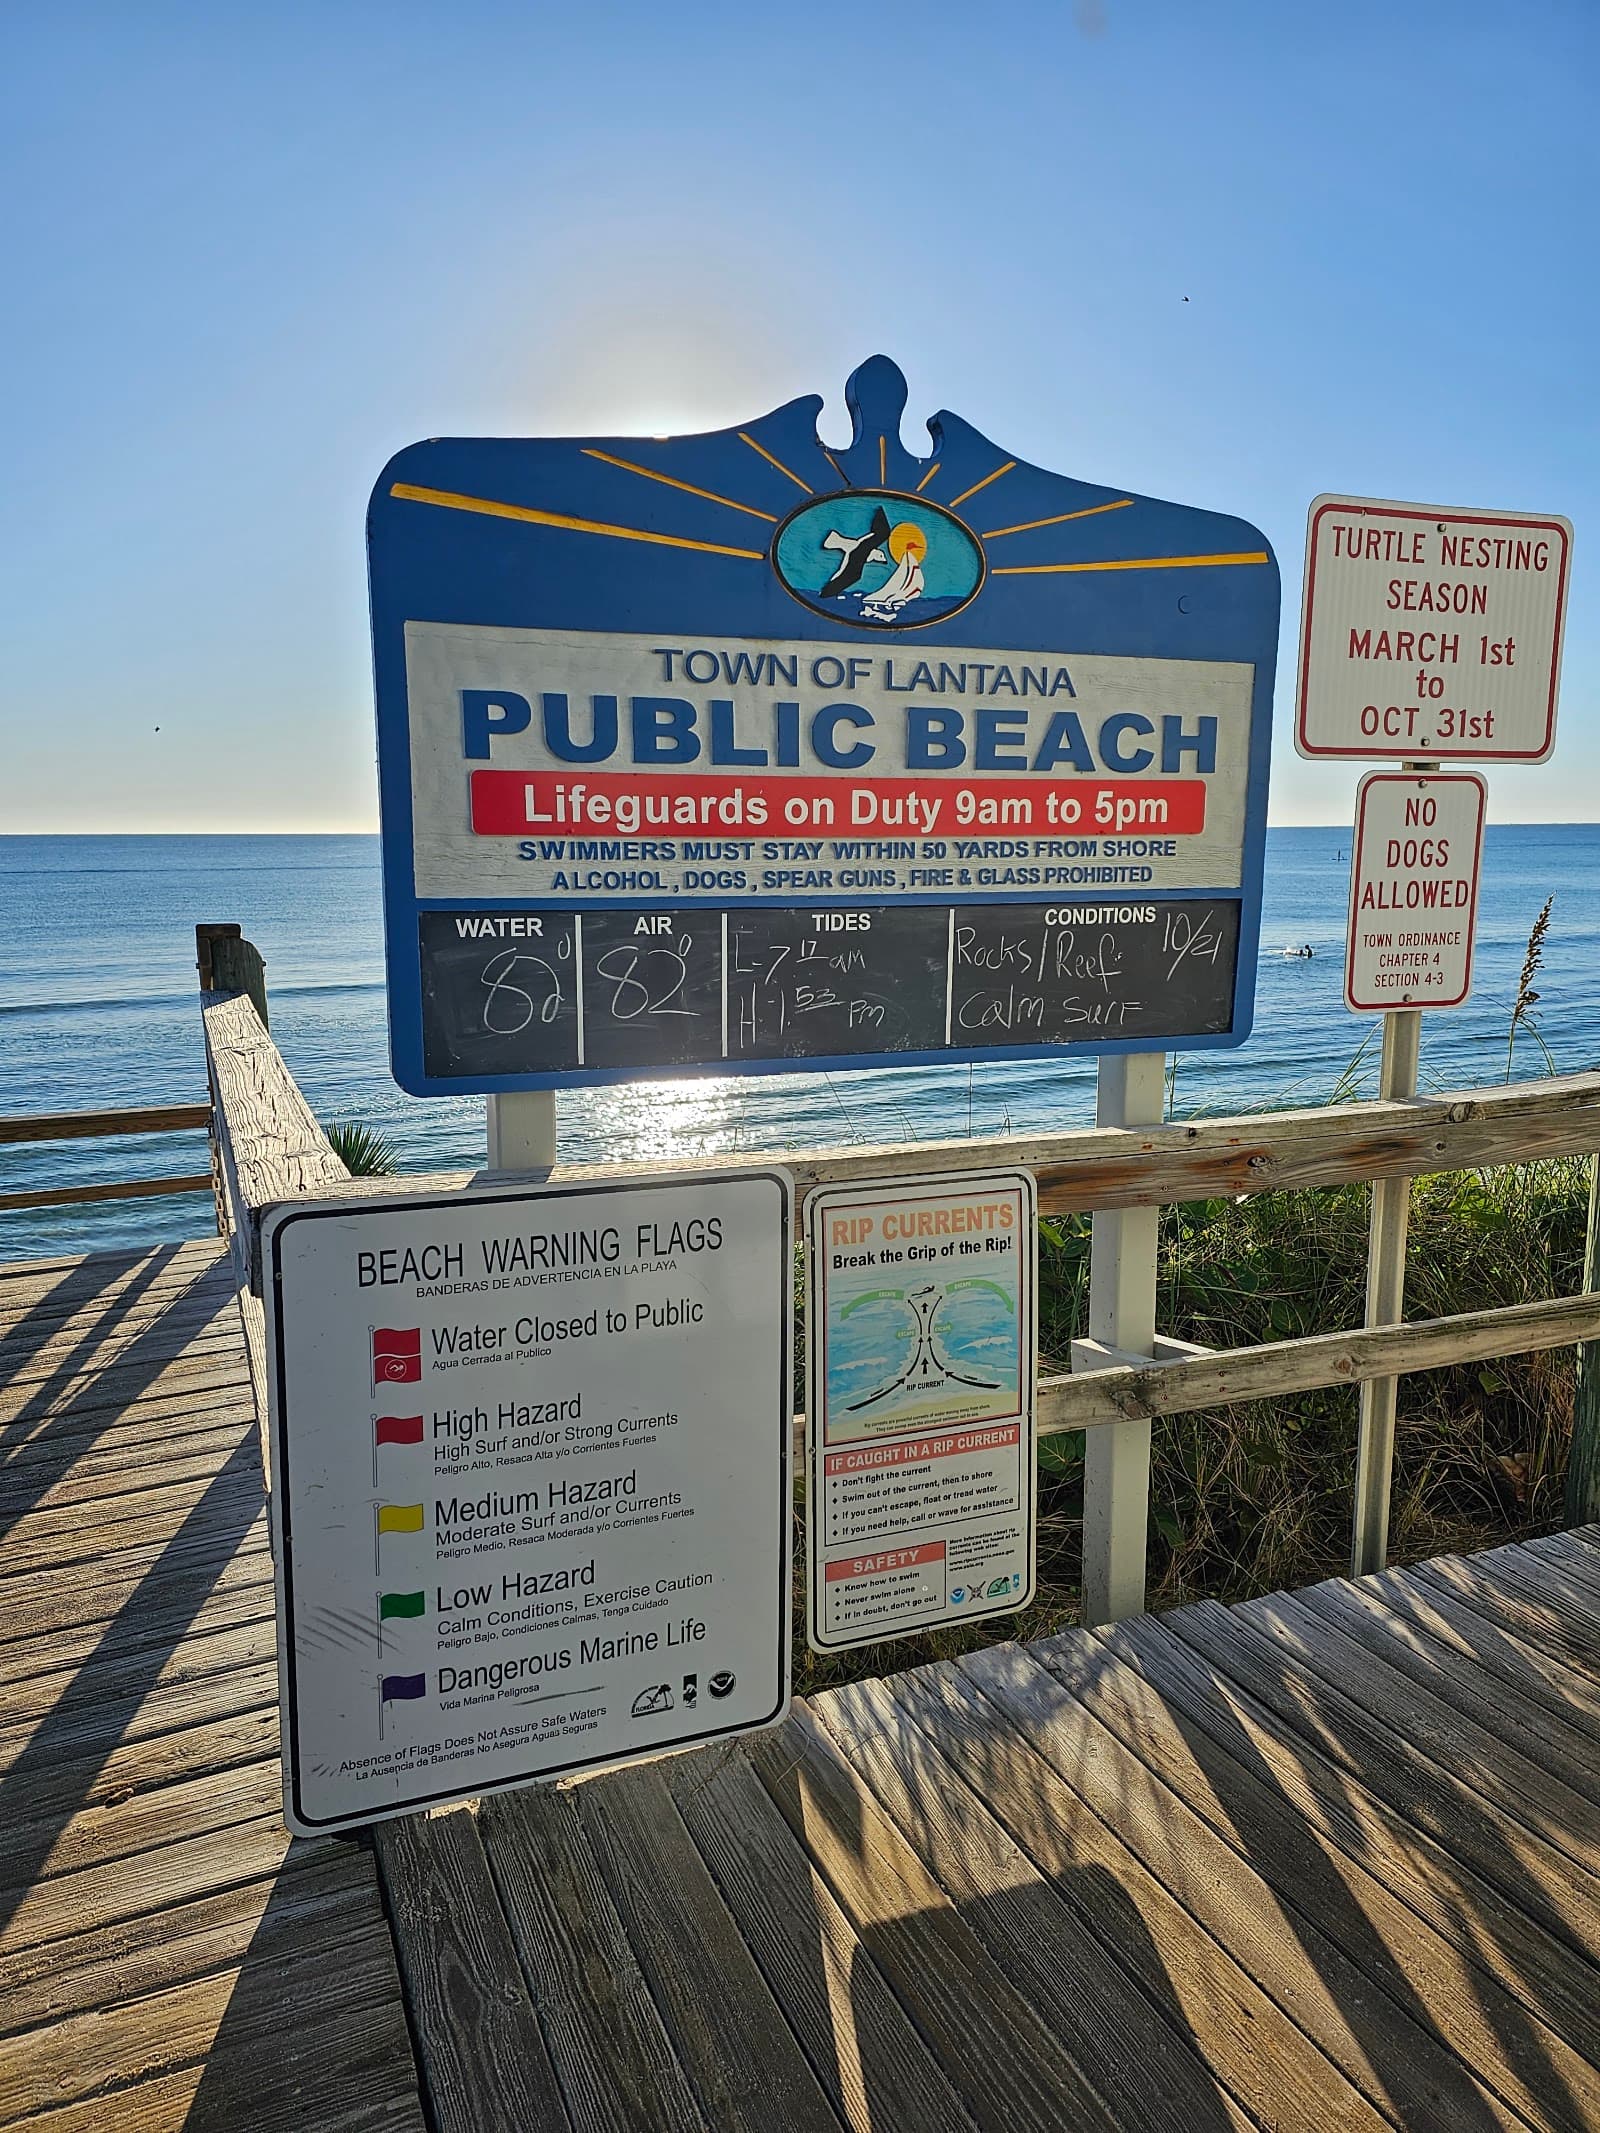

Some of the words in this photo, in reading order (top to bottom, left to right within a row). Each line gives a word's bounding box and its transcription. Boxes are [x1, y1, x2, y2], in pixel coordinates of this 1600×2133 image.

[1333, 526, 1425, 563] TURTLE
[1441, 536, 1548, 571] NESTING
[1387, 580, 1487, 614] SEASON
[1349, 629, 1459, 663] MARCH
[1481, 636, 1515, 665] 1st
[653, 649, 798, 688] TOWN
[811, 656, 873, 690] OF
[885, 659, 1077, 698] LANTANA
[1416, 669, 1444, 698] to
[461, 689, 876, 769] PUBLIC
[905, 707, 1218, 774] BEACH
[1361, 706, 1420, 736] OCT
[1437, 709, 1495, 738] 31st
[524, 784, 768, 833] Lifeguards
[784, 797, 834, 825] on
[851, 789, 942, 833] Duty
[956, 790, 1032, 825] 9am
[1046, 792, 1081, 824] to
[1095, 791, 1168, 831] 5pm
[1405, 798, 1437, 826] NO
[518, 840, 676, 860] SWIMMERS
[683, 842, 755, 860] MUST
[763, 841, 823, 861] STAY
[833, 842, 920, 860] WITHIN
[922, 842, 947, 859] 50
[954, 841, 1029, 858] YARDS
[1035, 841, 1097, 858] FROM
[1103, 840, 1176, 857] SHORE
[1387, 839, 1449, 868] DOGS
[763, 870, 833, 888] SPEAR
[911, 870, 953, 887] FIRE
[962, 869, 972, 885] &
[978, 867, 1040, 884] GLASS
[1045, 866, 1153, 884] PROHIBITED
[1361, 880, 1469, 910] ALLOWED
[456, 918, 544, 938] WATER
[633, 916, 672, 935] AIR
[812, 913, 871, 932] TIDES
[1045, 907, 1156, 926] CONDITIONS
[1364, 934, 1392, 947] TOWN
[1399, 932, 1460, 946] ORDINANCE
[1380, 954, 1428, 967] CHAPTER
[1433, 953, 1440, 965] 4
[1375, 973, 1419, 987] SECTION
[1425, 972, 1443, 985] 4-3
[833, 1217, 873, 1246] RIP
[883, 1204, 1014, 1240] CURRENTS
[358, 1243, 463, 1287] BEACH
[482, 1228, 620, 1274] WARNING
[638, 1218, 722, 1257] FLAGS
[833, 1252, 875, 1269] Break
[880, 1250, 903, 1264] the
[908, 1245, 936, 1261] Grip
[941, 1243, 954, 1256] of
[959, 1240, 981, 1254] the
[986, 1236, 1011, 1254] Rip!
[416, 1281, 488, 1297] BANDERAS
[493, 1279, 510, 1289] DE
[514, 1268, 602, 1287] ADVERTENCIA
[605, 1266, 620, 1277] EN
[625, 1264, 638, 1274] LA
[642, 1260, 677, 1272] PLAYA
[432, 1325, 507, 1355] Water
[515, 1310, 597, 1344] Closed
[606, 1308, 626, 1333] to
[636, 1298, 703, 1329] Public
[432, 1360, 459, 1370] Agua
[462, 1354, 501, 1365] Cerrada
[505, 1352, 513, 1360] al
[517, 1347, 551, 1358] Publico
[918, 1380, 944, 1390] CURRENT
[434, 1407, 488, 1441] High
[499, 1393, 581, 1430] Hazard
[435, 1443, 470, 1461] High
[475, 1436, 507, 1454] Surf
[512, 1431, 560, 1448] and/or
[565, 1424, 612, 1440] Strong
[618, 1413, 678, 1432] Currents
[831, 1458, 843, 1471] IF
[847, 1448, 900, 1467] CAUGHT
[905, 1446, 917, 1458] IN
[921, 1444, 929, 1455] A
[934, 1440, 953, 1453] RIP
[958, 1430, 1014, 1449] CURRENT
[435, 1464, 469, 1476] Peligro
[471, 1460, 493, 1470] Alto,
[496, 1455, 532, 1466] Resaca
[535, 1451, 553, 1460] Alta
[556, 1448, 570, 1459] y/o
[573, 1440, 620, 1455] Corrientes
[435, 1492, 538, 1526] Medium
[549, 1469, 636, 1507] Hazard
[436, 1522, 515, 1546] Moderate
[522, 1512, 555, 1530] Surf
[560, 1505, 611, 1524] and/or
[616, 1492, 681, 1513] Currents
[437, 1547, 470, 1560] Peligro
[474, 1542, 506, 1553] Medio,
[509, 1534, 545, 1547] Resaca
[548, 1526, 593, 1540] Moderada
[597, 1523, 610, 1534] y/o
[613, 1514, 659, 1529] Corrientes
[662, 1508, 695, 1520] Fuertes
[853, 1550, 919, 1573] SAFETY
[437, 1584, 492, 1612] Low
[503, 1560, 595, 1600] Hazard
[438, 1618, 481, 1636] Calm
[488, 1600, 578, 1626] Conditions,
[584, 1585, 650, 1608] Exercise
[656, 1574, 713, 1593] Caution
[438, 1638, 471, 1650] Peligro
[475, 1633, 498, 1643] Bajo,
[502, 1620, 559, 1637] Condiciones
[562, 1613, 599, 1625] Calmas,
[602, 1606, 629, 1617] Tenga
[632, 1598, 668, 1611] Cuidado
[439, 1649, 571, 1693] Dangerous
[580, 1632, 658, 1664] Marine
[668, 1618, 706, 1646] Life
[440, 1700, 461, 1711] Vida
[464, 1694, 495, 1707] Marina
[498, 1684, 540, 1699] Peligrosa
[340, 1754, 391, 1772] Absence
[395, 1748, 406, 1760] of
[410, 1743, 441, 1757] Flags
[445, 1736, 474, 1749] Does
[478, 1730, 498, 1742] Not
[500, 1722, 538, 1738] Assure
[542, 1715, 566, 1728] Safe
[570, 1707, 606, 1721] Waters
[356, 1772, 368, 1780] La
[371, 1761, 414, 1777] Ausencia
[417, 1758, 428, 1767] de
[432, 1748, 474, 1764] Banderas
[478, 1745, 490, 1754] No
[493, 1737, 529, 1750] Asegura
[532, 1730, 560, 1742] Aguas
[563, 1721, 598, 1734] Seguras
